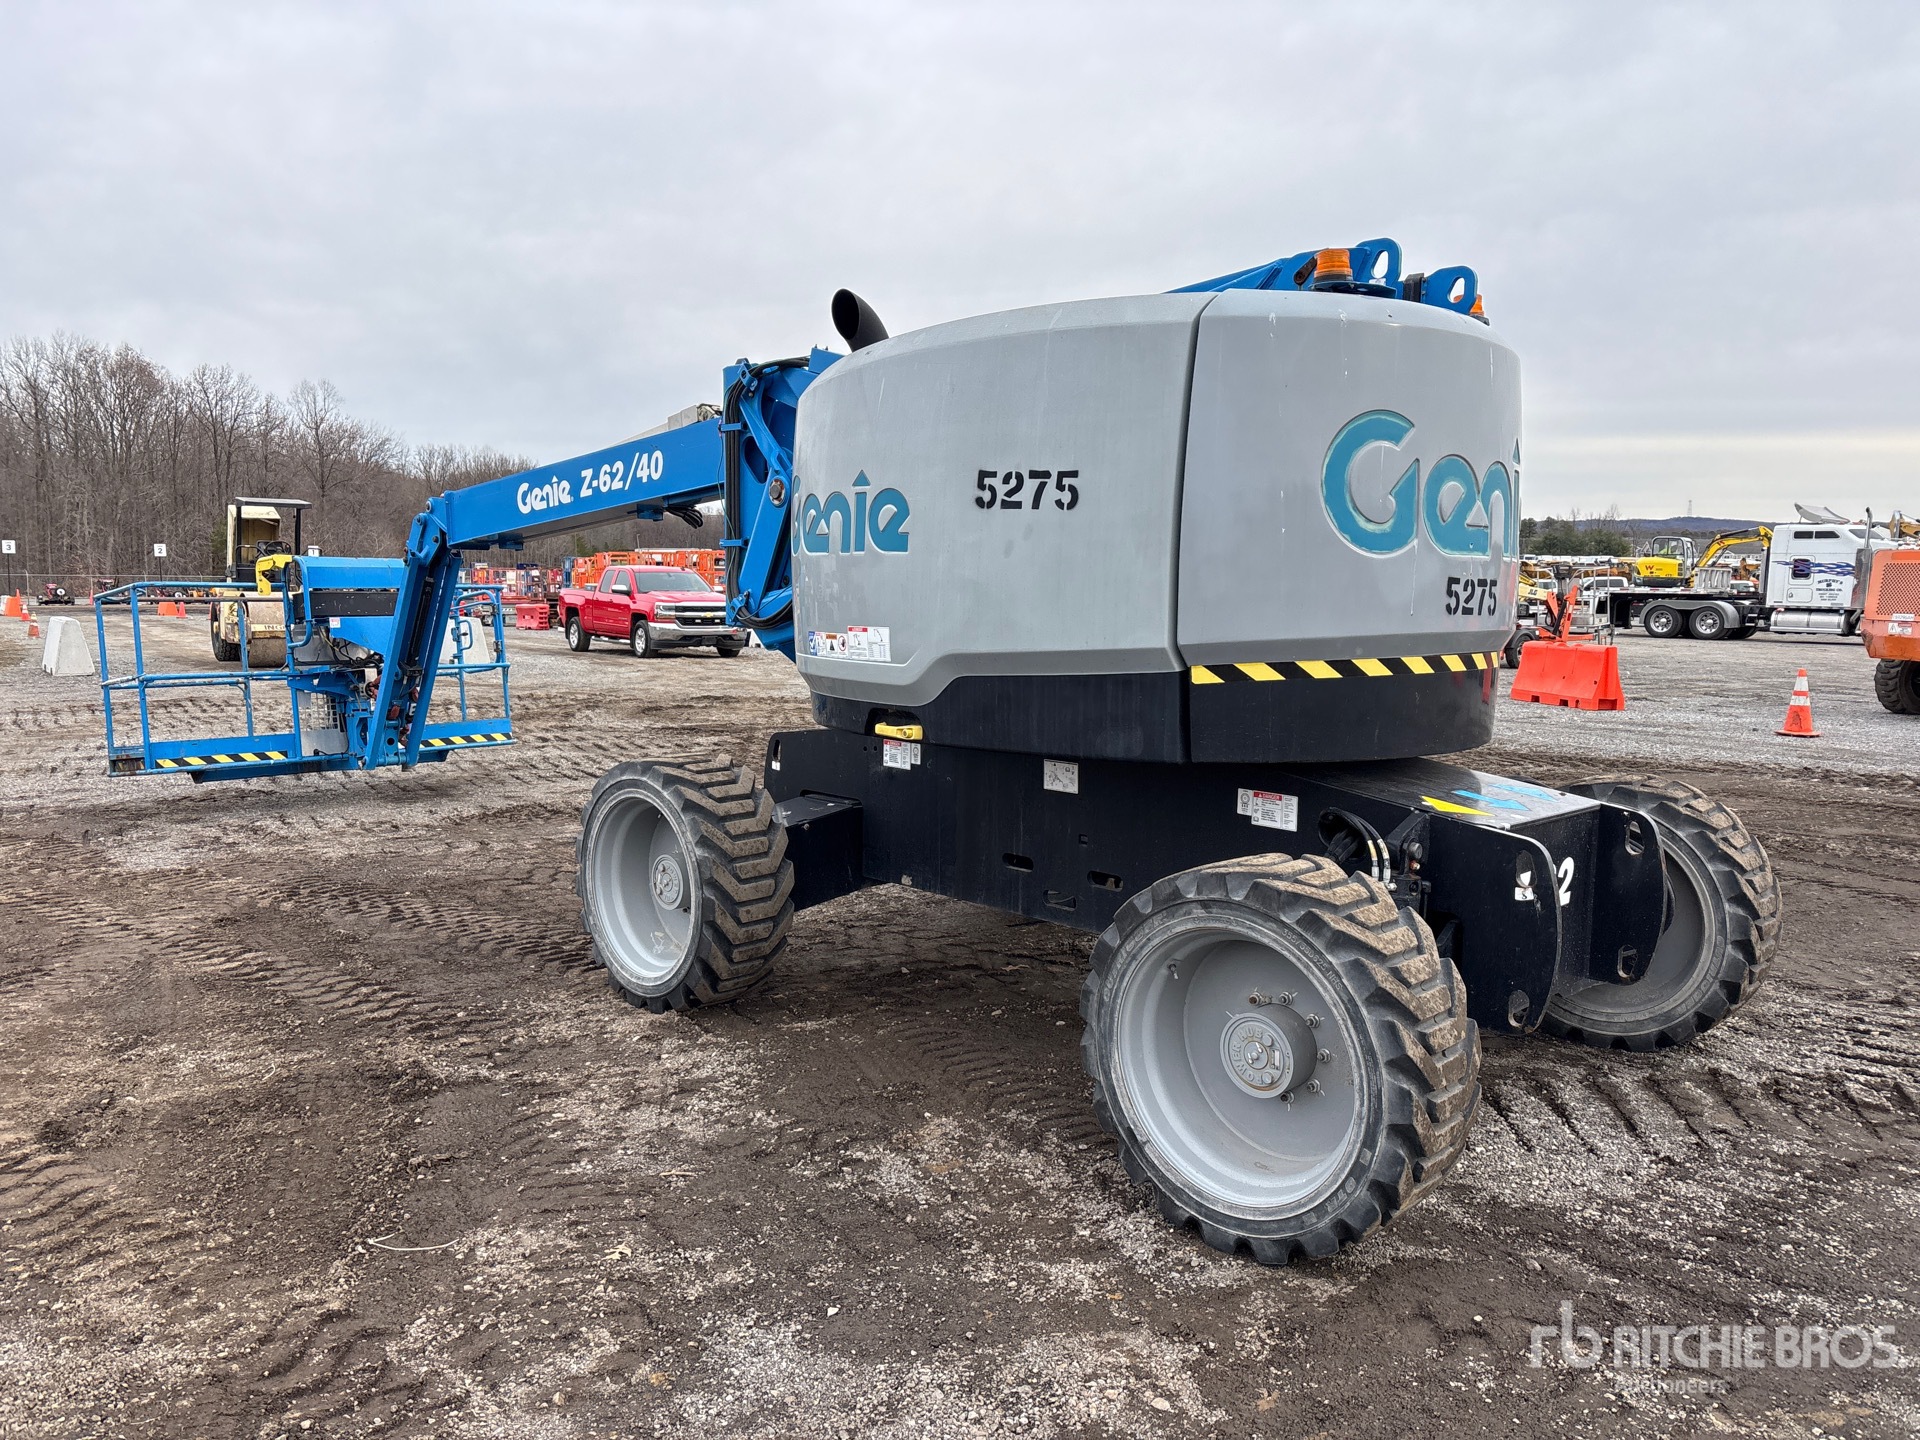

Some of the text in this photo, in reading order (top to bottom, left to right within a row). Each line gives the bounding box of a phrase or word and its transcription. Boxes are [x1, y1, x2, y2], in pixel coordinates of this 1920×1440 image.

[517, 450, 664, 514] Genie Z-62/40
[975, 469, 1080, 511] 5275
[1320, 409, 1520, 560] Geni
[1446, 576, 1498, 616] 5275
[1326, 970, 1343, 990] NHS
